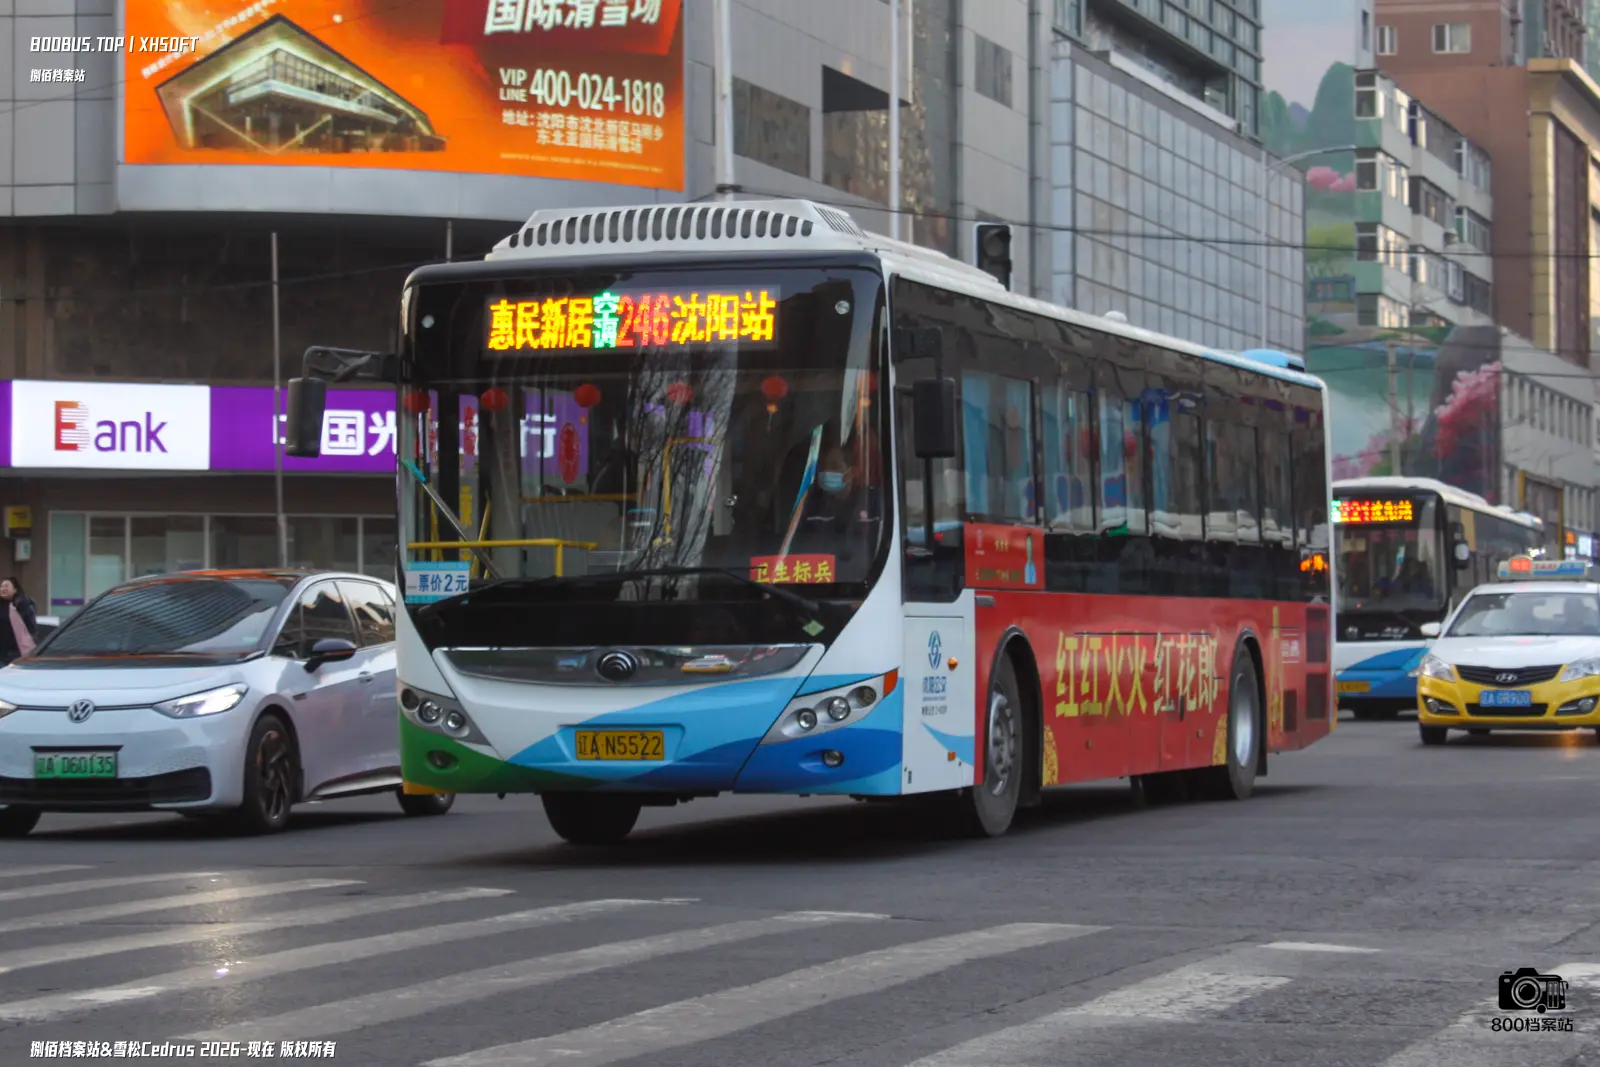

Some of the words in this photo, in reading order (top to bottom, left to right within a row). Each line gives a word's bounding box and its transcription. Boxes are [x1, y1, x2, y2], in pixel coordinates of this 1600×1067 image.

[499, 67, 527, 87] VIP
[499, 88, 527, 102] LINE
[530, 67, 665, 118] 400-024-1818
[488, 298, 592, 350] 惠民新居
[617, 292, 670, 347] 246
[671, 290, 776, 345] 沈阳站
[419, 573, 468, 592] 票价2元
[756, 560, 832, 584] 卫生标兵
